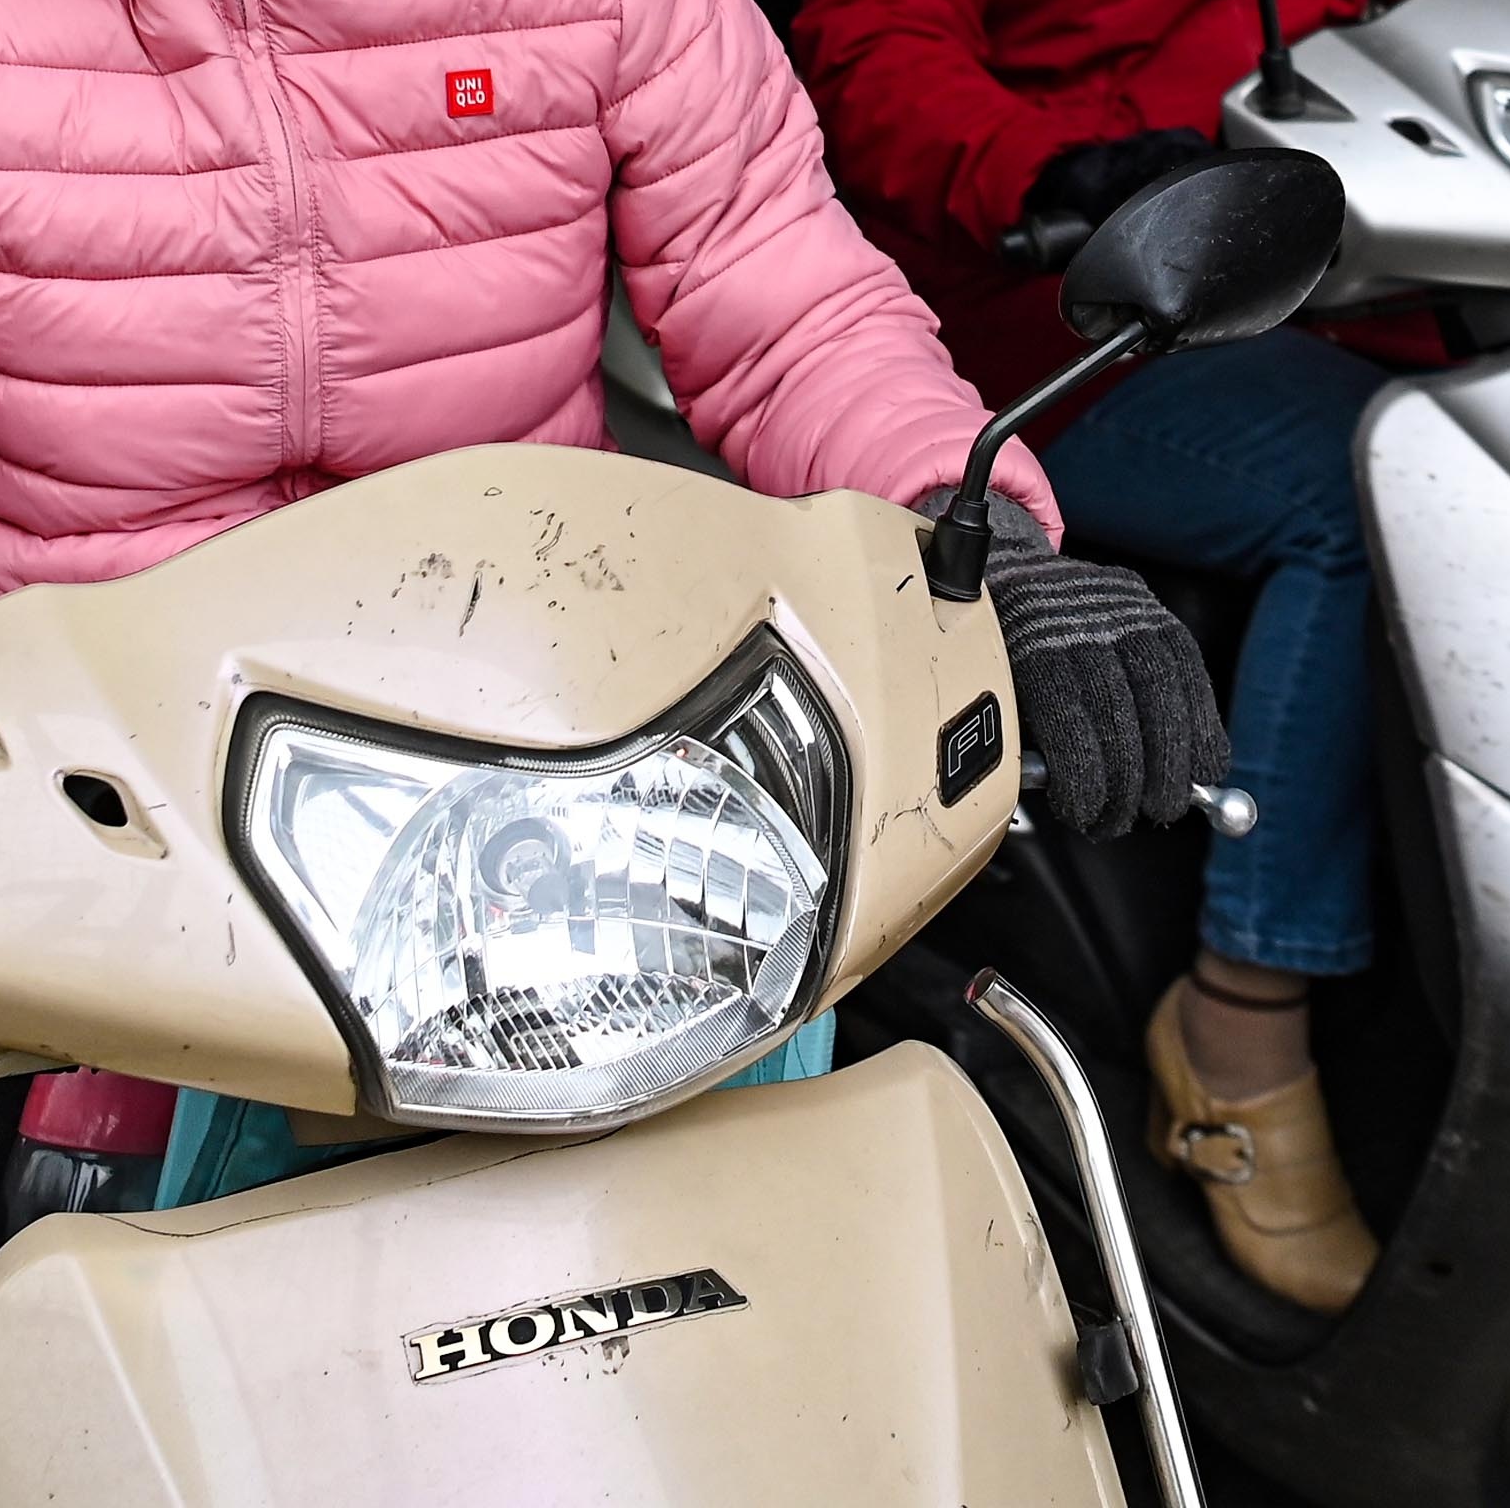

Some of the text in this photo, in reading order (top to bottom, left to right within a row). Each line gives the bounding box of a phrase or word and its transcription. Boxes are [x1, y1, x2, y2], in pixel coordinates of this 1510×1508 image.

[455, 77, 482, 91] UNI
[456, 90, 486, 108] QLO
[948, 704, 995, 778] FI
[411, 1270, 747, 1379] HONDA
